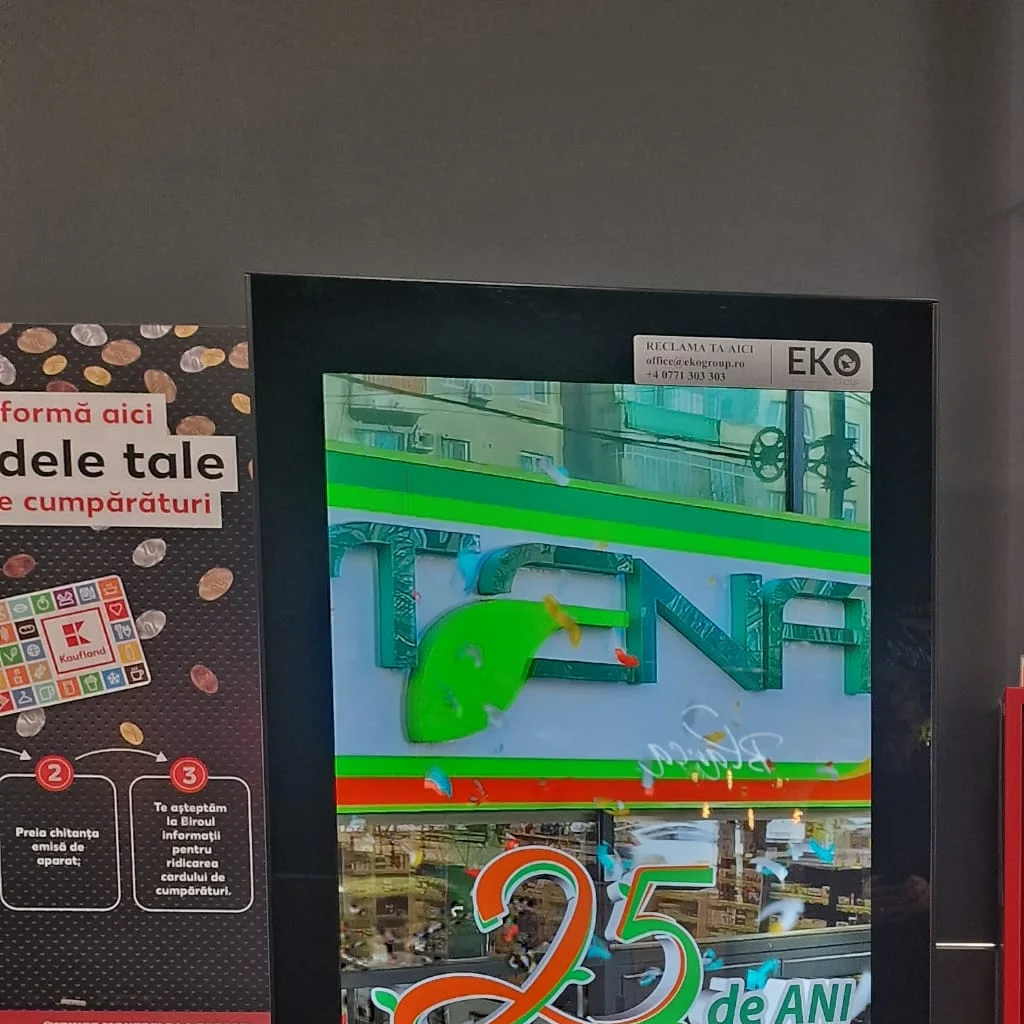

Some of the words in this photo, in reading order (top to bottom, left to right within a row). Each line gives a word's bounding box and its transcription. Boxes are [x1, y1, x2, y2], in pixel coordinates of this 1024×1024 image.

[646, 341, 706, 353] RECLAMA
[709, 343, 726, 353] TA
[729, 344, 754, 354] AICI
[646, 355, 746, 370] office@ekogroup.ro
[661, 371, 685, 380] 0771
[687, 372, 706, 381] 303
[708, 373, 726, 382] 303
[0, 401, 91, 424] formă
[102, 403, 153, 425] aici
[0, 438, 105, 477] dele
[123, 441, 225, 480] tale
[24, 491, 211, 518] cumpărături
[59, 646, 106, 665] Kaufland
[47, 763, 63, 782] 2
[182, 766, 197, 784] 3
[153, 802, 168, 813] Te
[167, 816, 178, 826] la
[181, 816, 216, 827] Biroul
[15, 827, 47, 838] Preia
[69, 842, 85, 852] de
[172, 845, 212, 856] pentru
[166, 858, 219, 868] ridicarea
[160, 872, 208, 882] cardului
[210, 873, 226, 882] de
